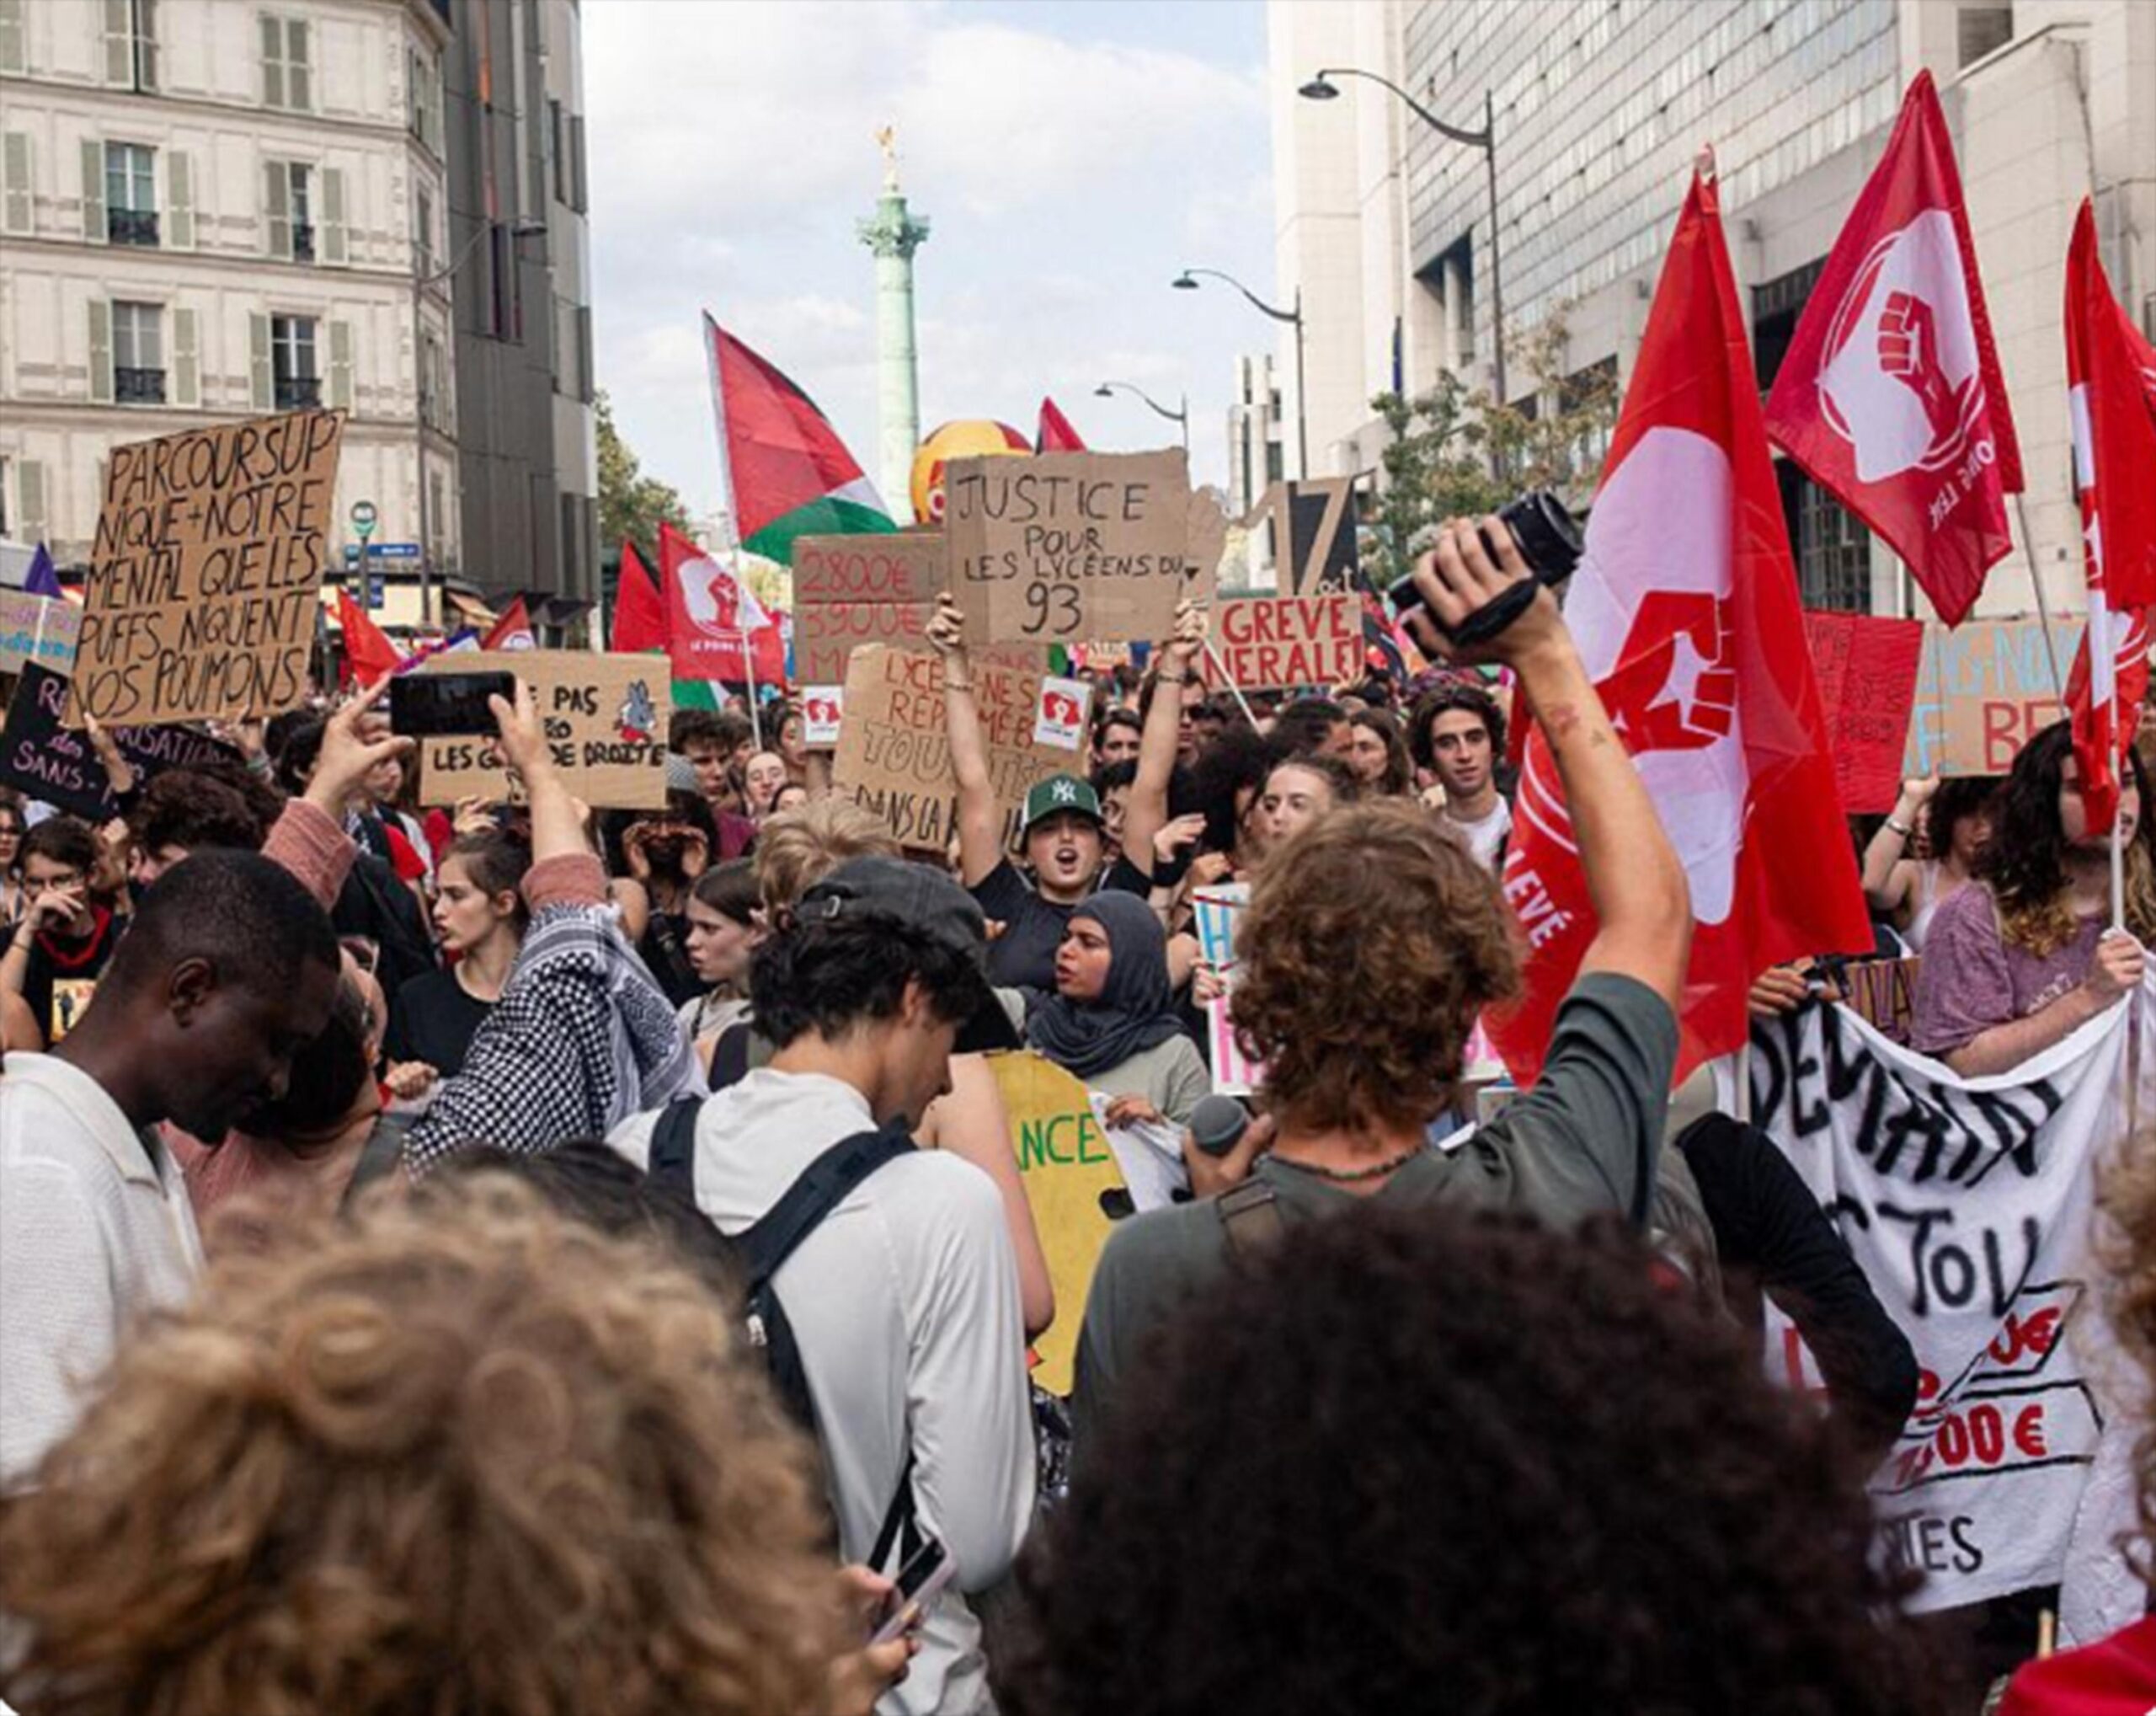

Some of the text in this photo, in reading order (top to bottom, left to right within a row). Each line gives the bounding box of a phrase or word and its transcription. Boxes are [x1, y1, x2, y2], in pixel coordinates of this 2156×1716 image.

[108, 416, 338, 504] PARCOURSUP
[956, 473, 1150, 523] JUSTICE
[964, 553, 1019, 581] LES
[1034, 552, 1154, 580] LYCÉENS
[1159, 554, 1184, 575] DU
[1024, 525, 1104, 556] POUR
[84, 548, 189, 612] MENTAL
[1020, 581, 1083, 635] 93
[1223, 597, 1352, 644] GREVE
[73, 611, 164, 671] PUFFS
[152, 648, 304, 714] POUMONS
[553, 684, 599, 716] PAS
[433, 746, 472, 771] LES
[583, 742, 668, 768] DROITE
[1020, 1113, 1109, 1172] NCE
